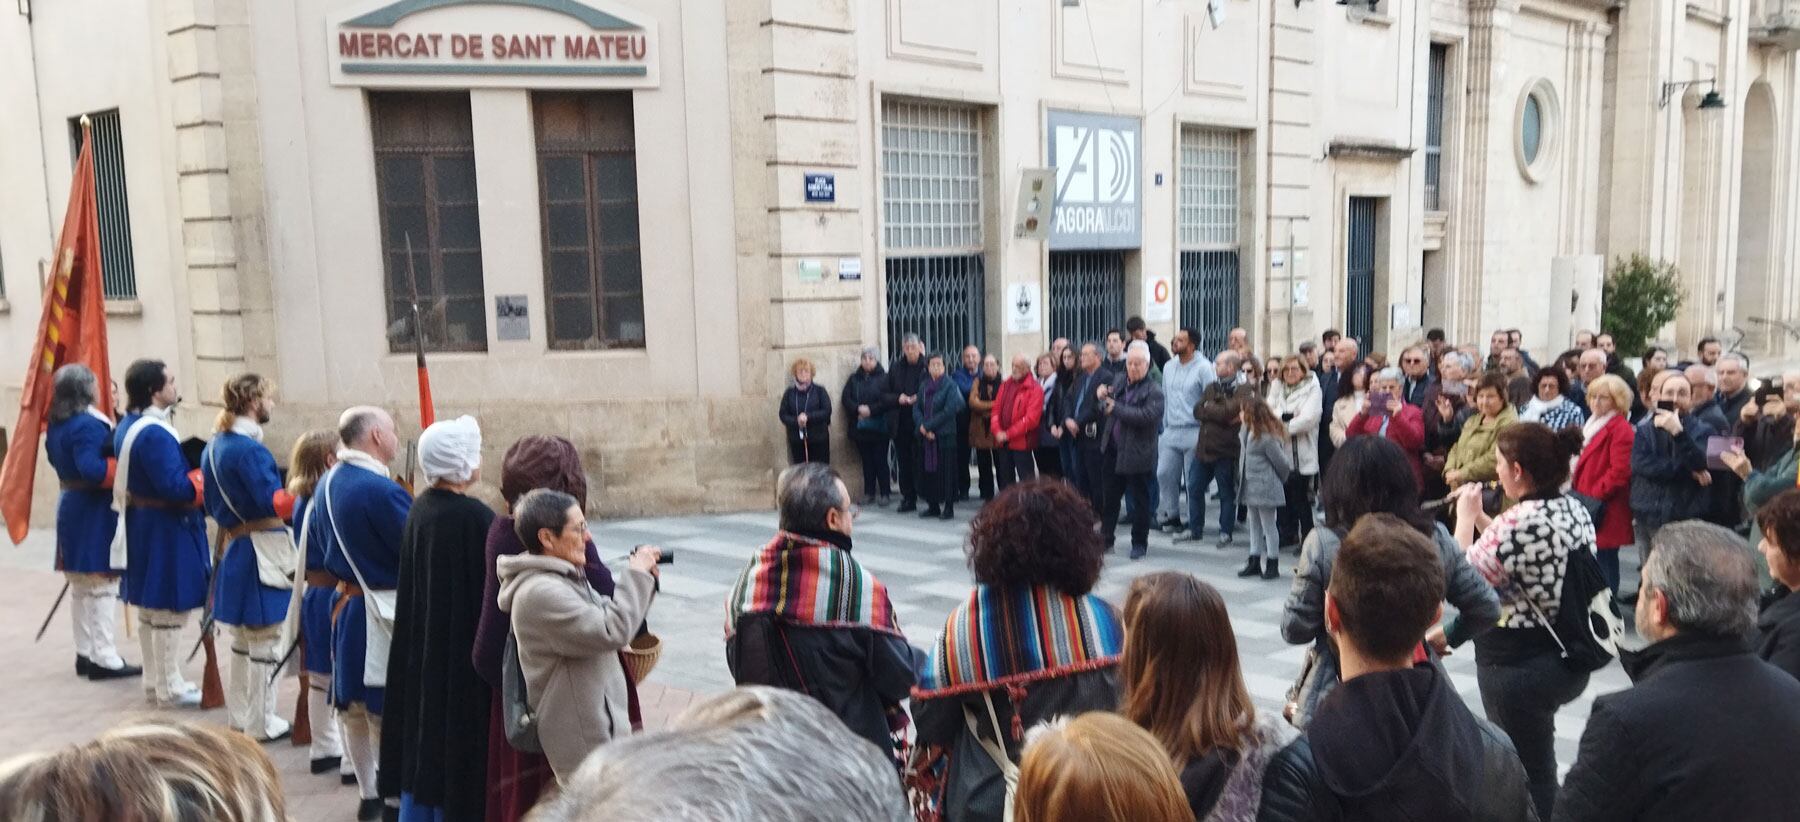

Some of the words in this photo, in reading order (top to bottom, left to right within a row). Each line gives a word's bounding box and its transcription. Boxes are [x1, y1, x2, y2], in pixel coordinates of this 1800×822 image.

[339, 32, 443, 58] MERCAT
[450, 33, 483, 59] DE
[491, 34, 556, 60] SANT
[565, 35, 646, 61] MATEU
